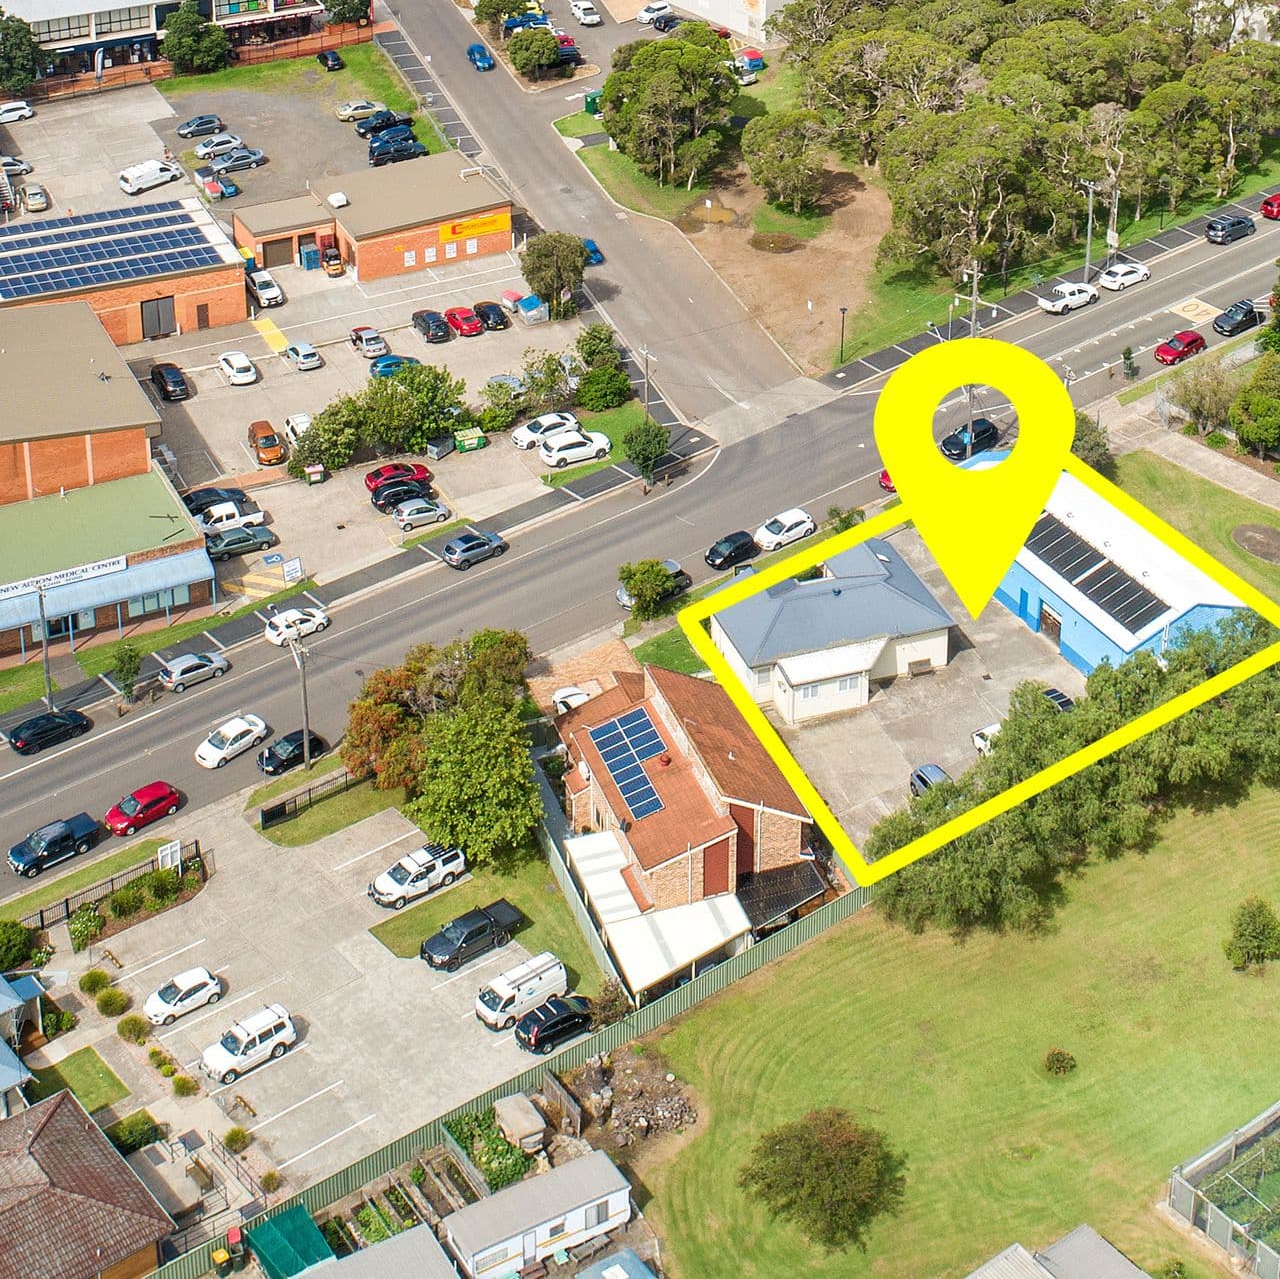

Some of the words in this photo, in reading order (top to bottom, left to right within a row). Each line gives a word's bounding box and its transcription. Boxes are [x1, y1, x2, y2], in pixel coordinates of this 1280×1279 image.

[0, 584, 19, 594] NEW
[54, 567, 89, 580] MEDICAL
[91, 559, 121, 571] CENTRE
